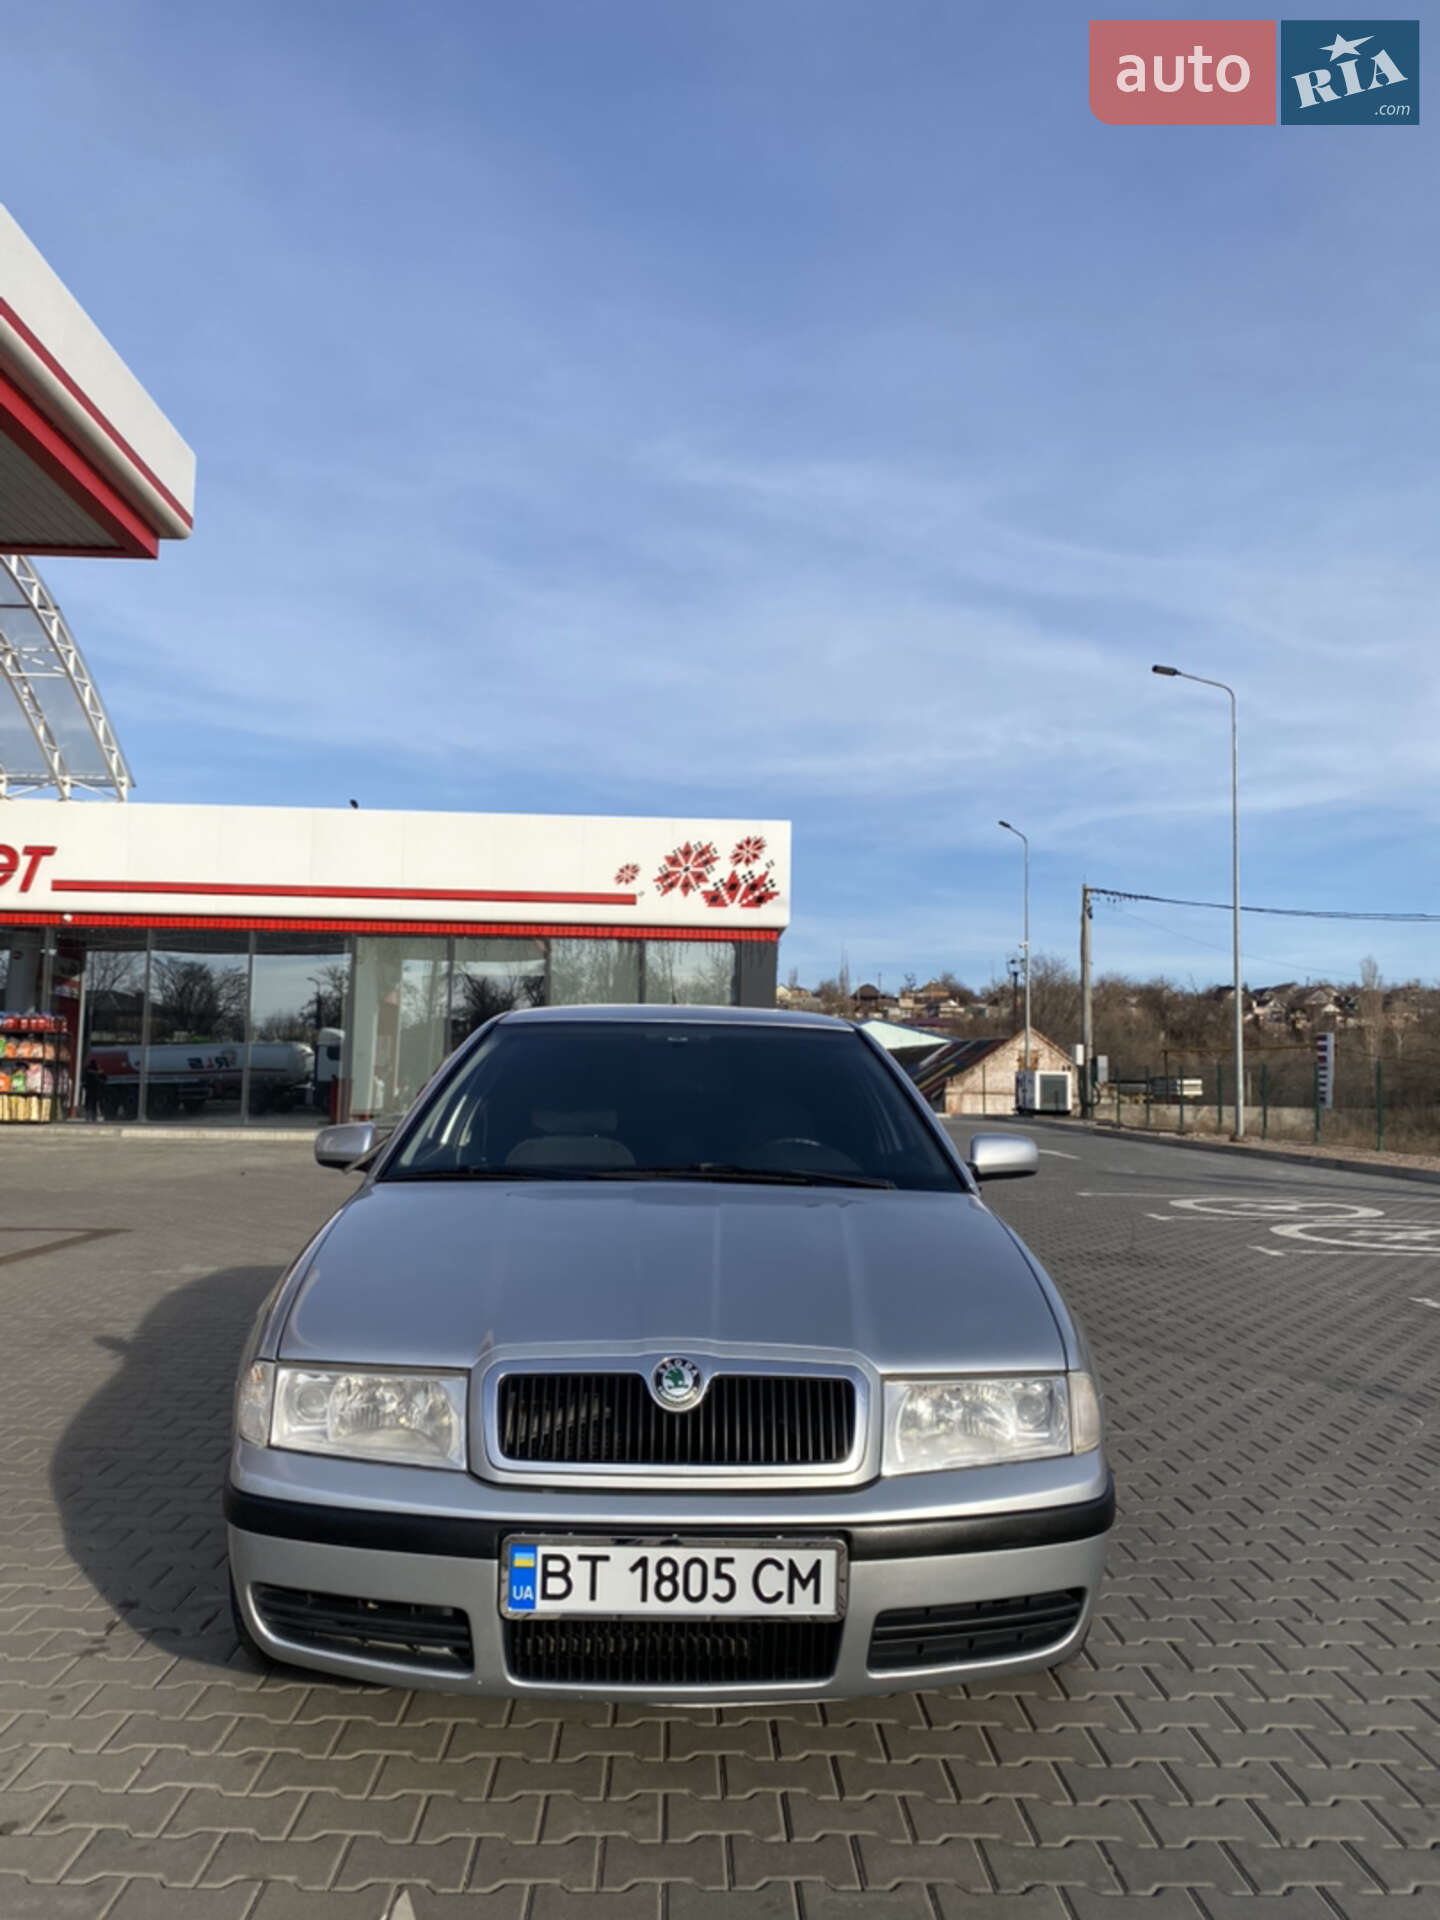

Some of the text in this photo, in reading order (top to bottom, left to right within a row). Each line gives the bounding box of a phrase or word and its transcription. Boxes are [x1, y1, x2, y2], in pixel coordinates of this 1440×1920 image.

[512, 1585, 535, 1601] UA
[540, 1553, 822, 1606] BT 1805 CM
